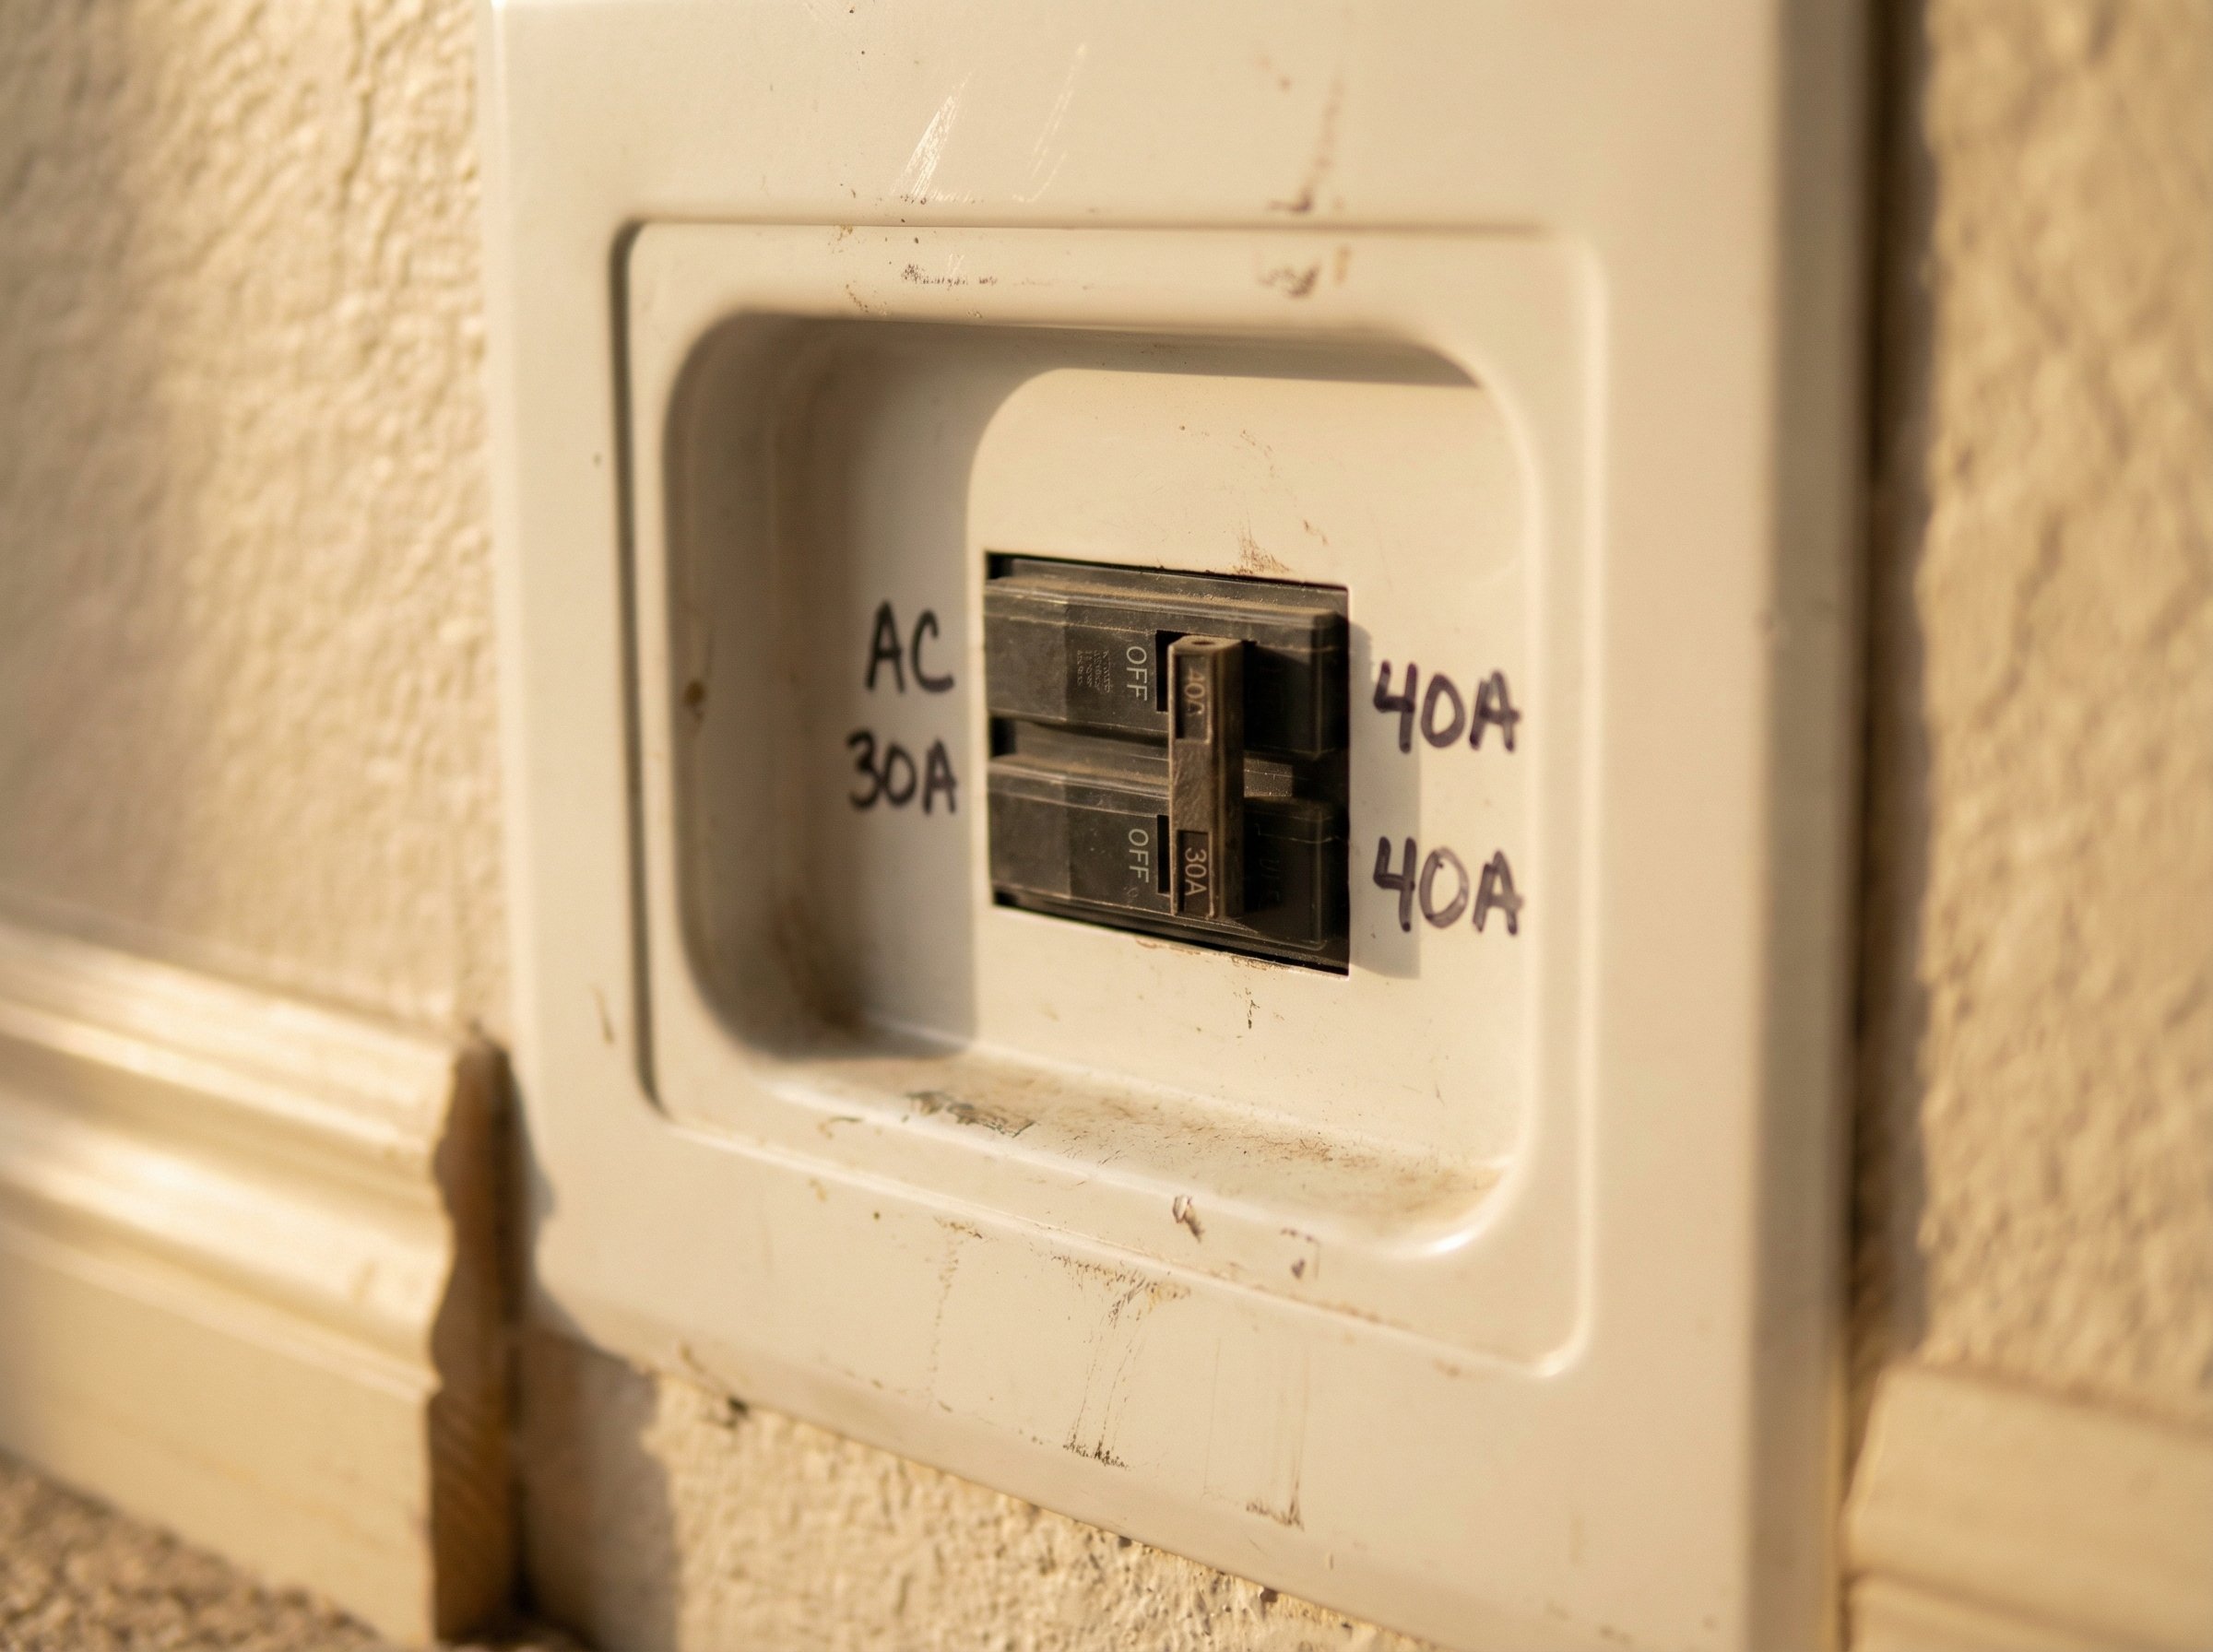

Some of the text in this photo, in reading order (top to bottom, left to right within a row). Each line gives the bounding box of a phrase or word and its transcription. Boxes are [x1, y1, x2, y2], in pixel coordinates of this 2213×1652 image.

[865, 600, 955, 694] AC
[1126, 645, 1148, 702] OFF
[1372, 659, 1521, 753] 40A
[846, 728, 957, 812] 30A
[1128, 828, 1150, 883] OFF
[1184, 847, 1208, 896] 30A
[1372, 835, 1524, 935] 40A
